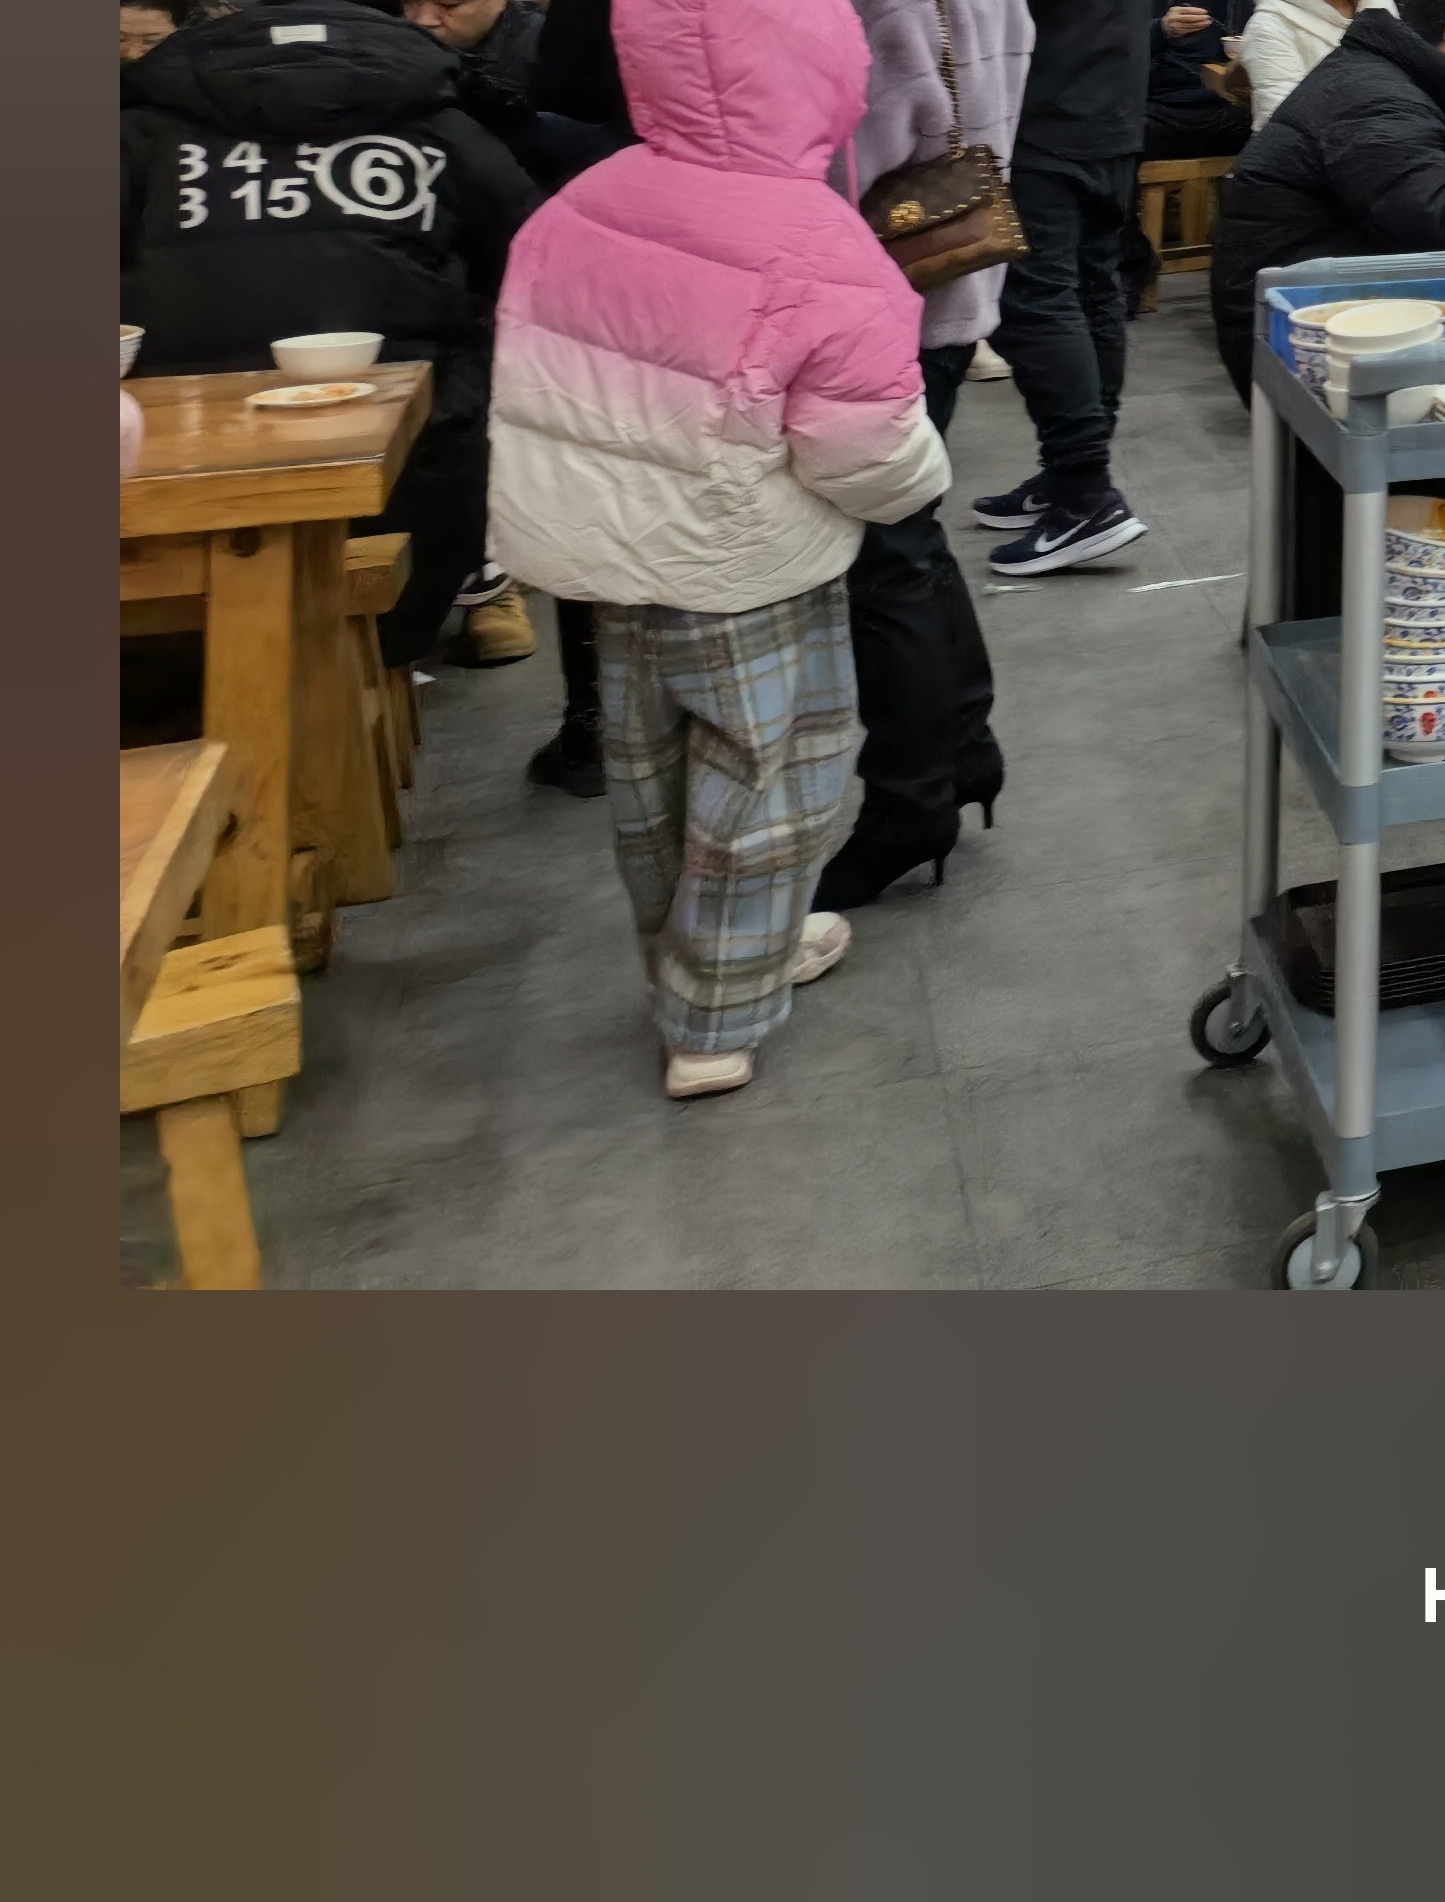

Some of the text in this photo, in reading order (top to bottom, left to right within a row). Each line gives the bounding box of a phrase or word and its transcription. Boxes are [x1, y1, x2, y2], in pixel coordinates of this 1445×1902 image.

[222, 140, 268, 174] 4
[350, 148, 404, 206] 6
[231, 176, 312, 220] 15
